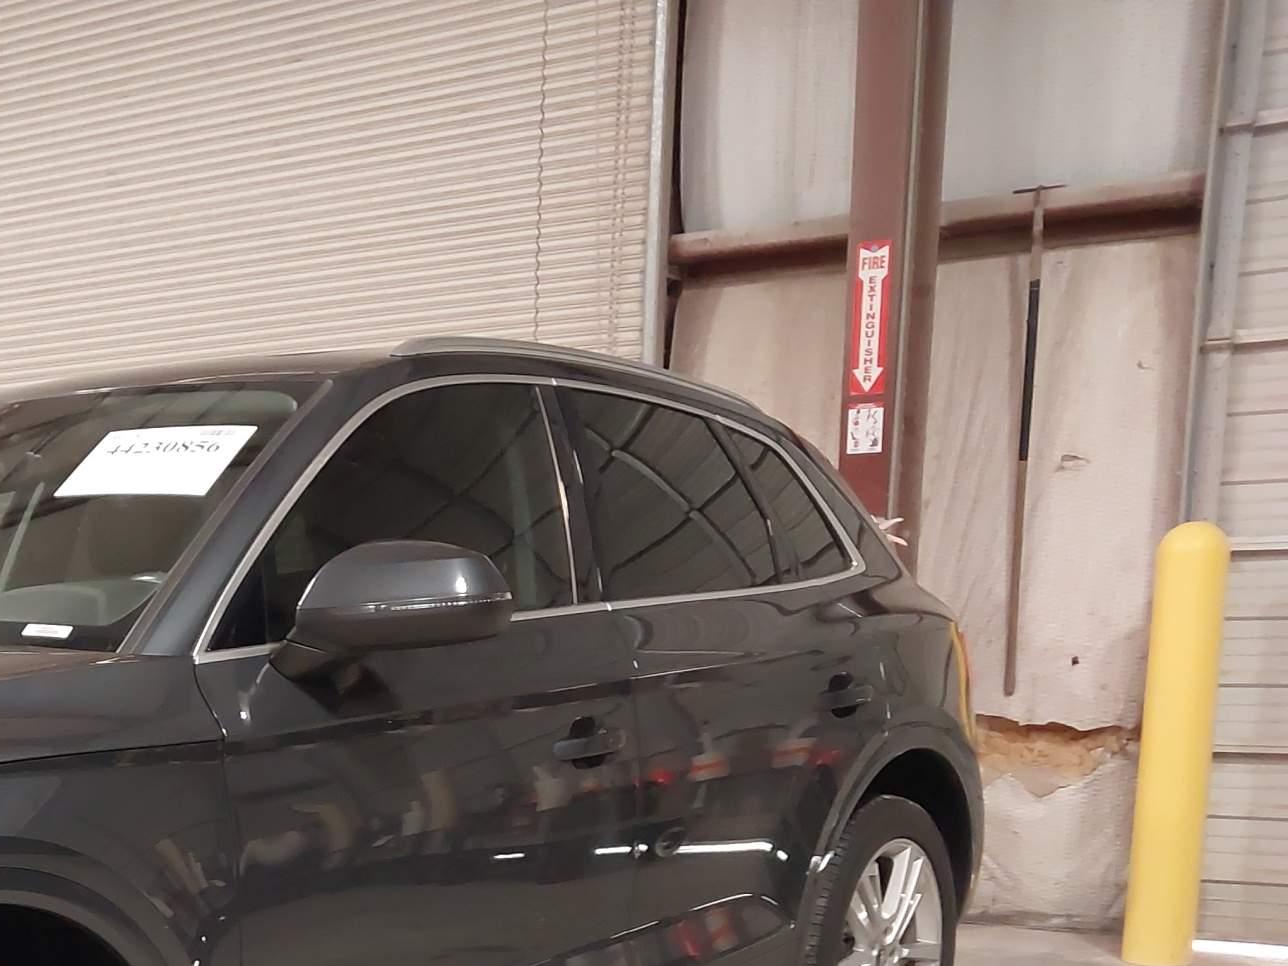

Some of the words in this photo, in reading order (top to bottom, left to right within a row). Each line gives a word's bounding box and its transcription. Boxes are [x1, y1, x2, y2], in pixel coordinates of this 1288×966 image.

[861, 255, 886, 271] FIRE
[862, 276, 878, 383] EXTINGUISHER
[106, 440, 221, 455] 44230856
